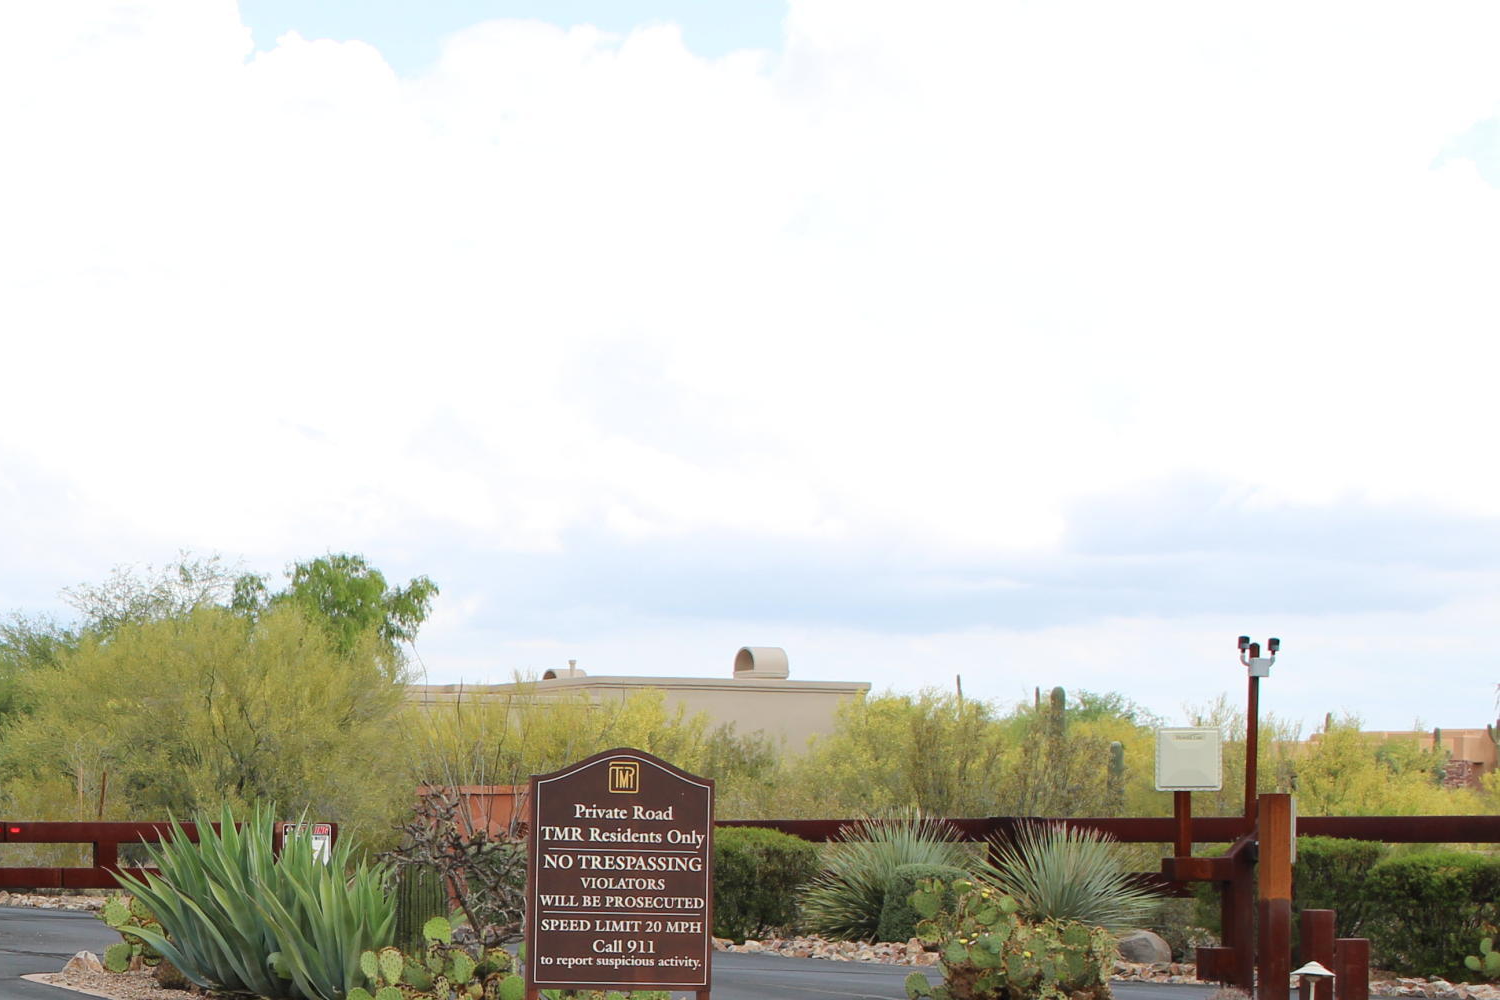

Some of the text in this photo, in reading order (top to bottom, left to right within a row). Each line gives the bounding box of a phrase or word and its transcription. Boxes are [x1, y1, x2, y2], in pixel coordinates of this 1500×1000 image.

[574, 804, 673, 821] Private Road
[541, 826, 705, 849] TMR Residents Only
[543, 854, 702, 872] NO TRESPASSING
[580, 877, 665, 891] VIOLATORS
[540, 895, 705, 909] WILL BE PROSECUTED
[540, 919, 702, 933] SPEED LIMIT 20 MPH
[592, 939, 655, 953] Call 911
[540, 956, 701, 970] to report suspicious activity.
